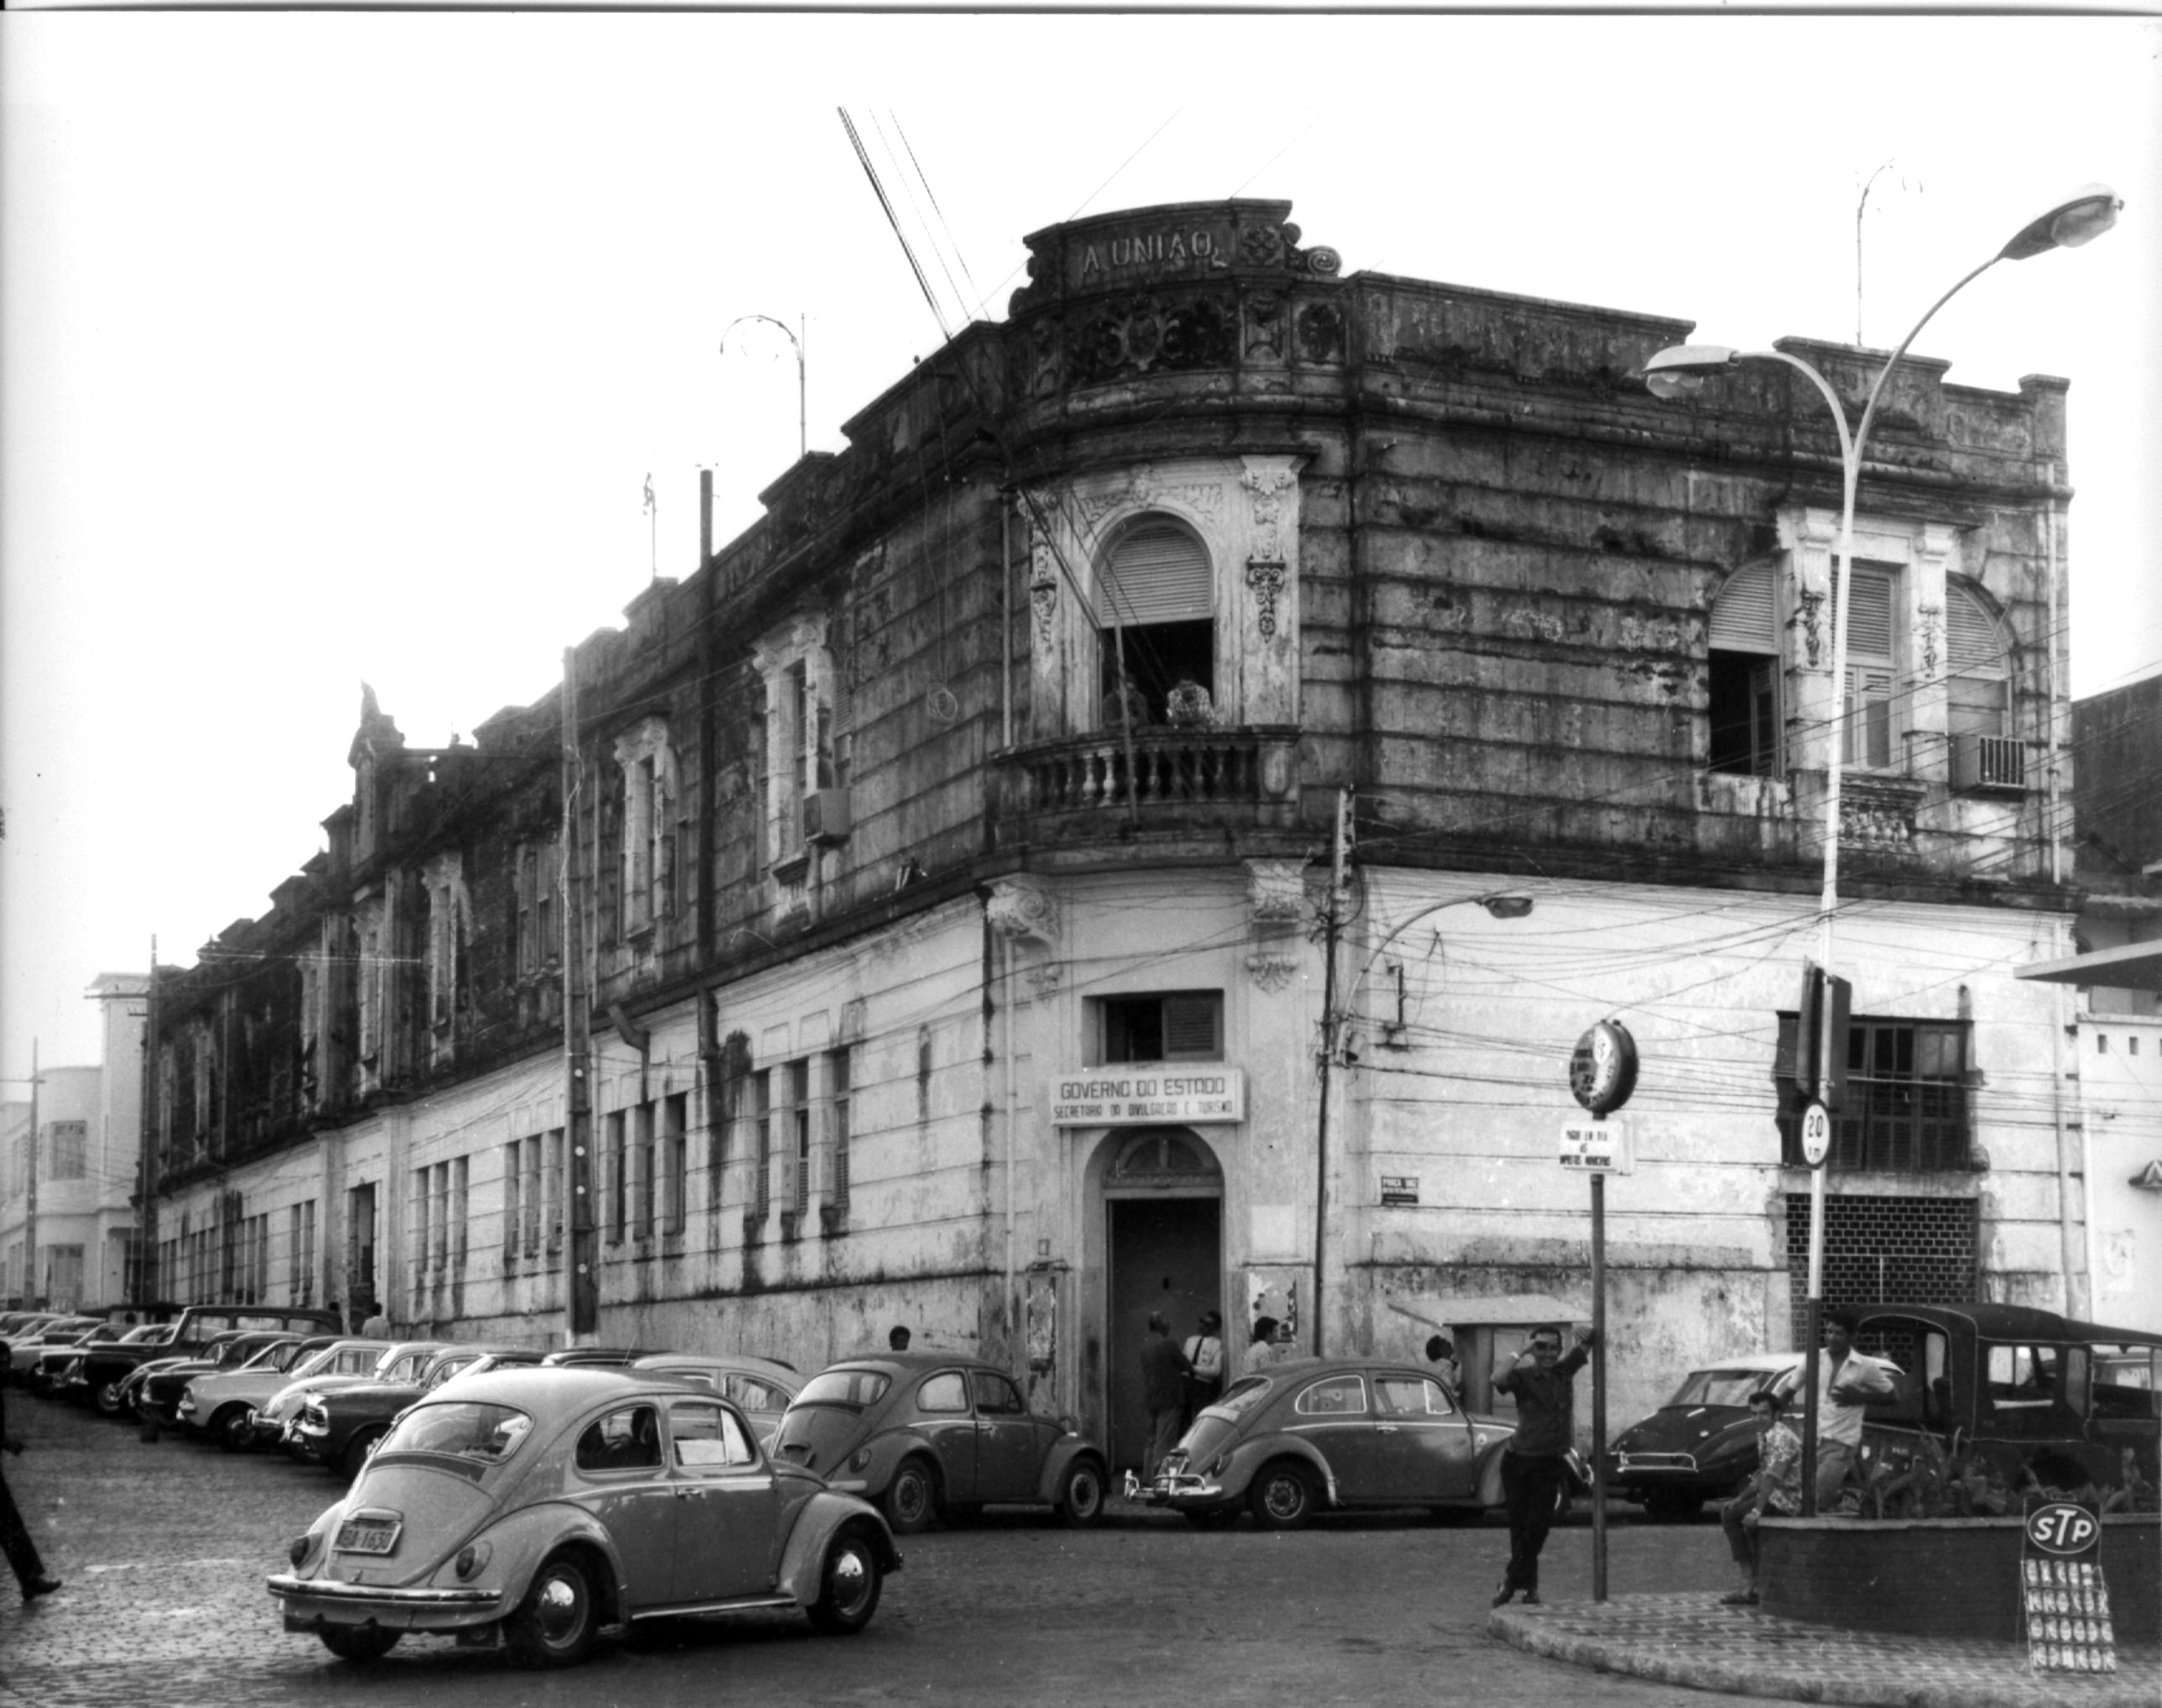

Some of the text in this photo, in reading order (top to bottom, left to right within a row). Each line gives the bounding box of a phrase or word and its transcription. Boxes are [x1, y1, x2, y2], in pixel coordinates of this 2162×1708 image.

[1083, 245, 1099, 273] A
[1061, 1077, 1225, 1099] GOVERNO DO ESTADO
[1808, 1115, 1824, 1138] 20
[2034, 1509, 2092, 1546] STP
